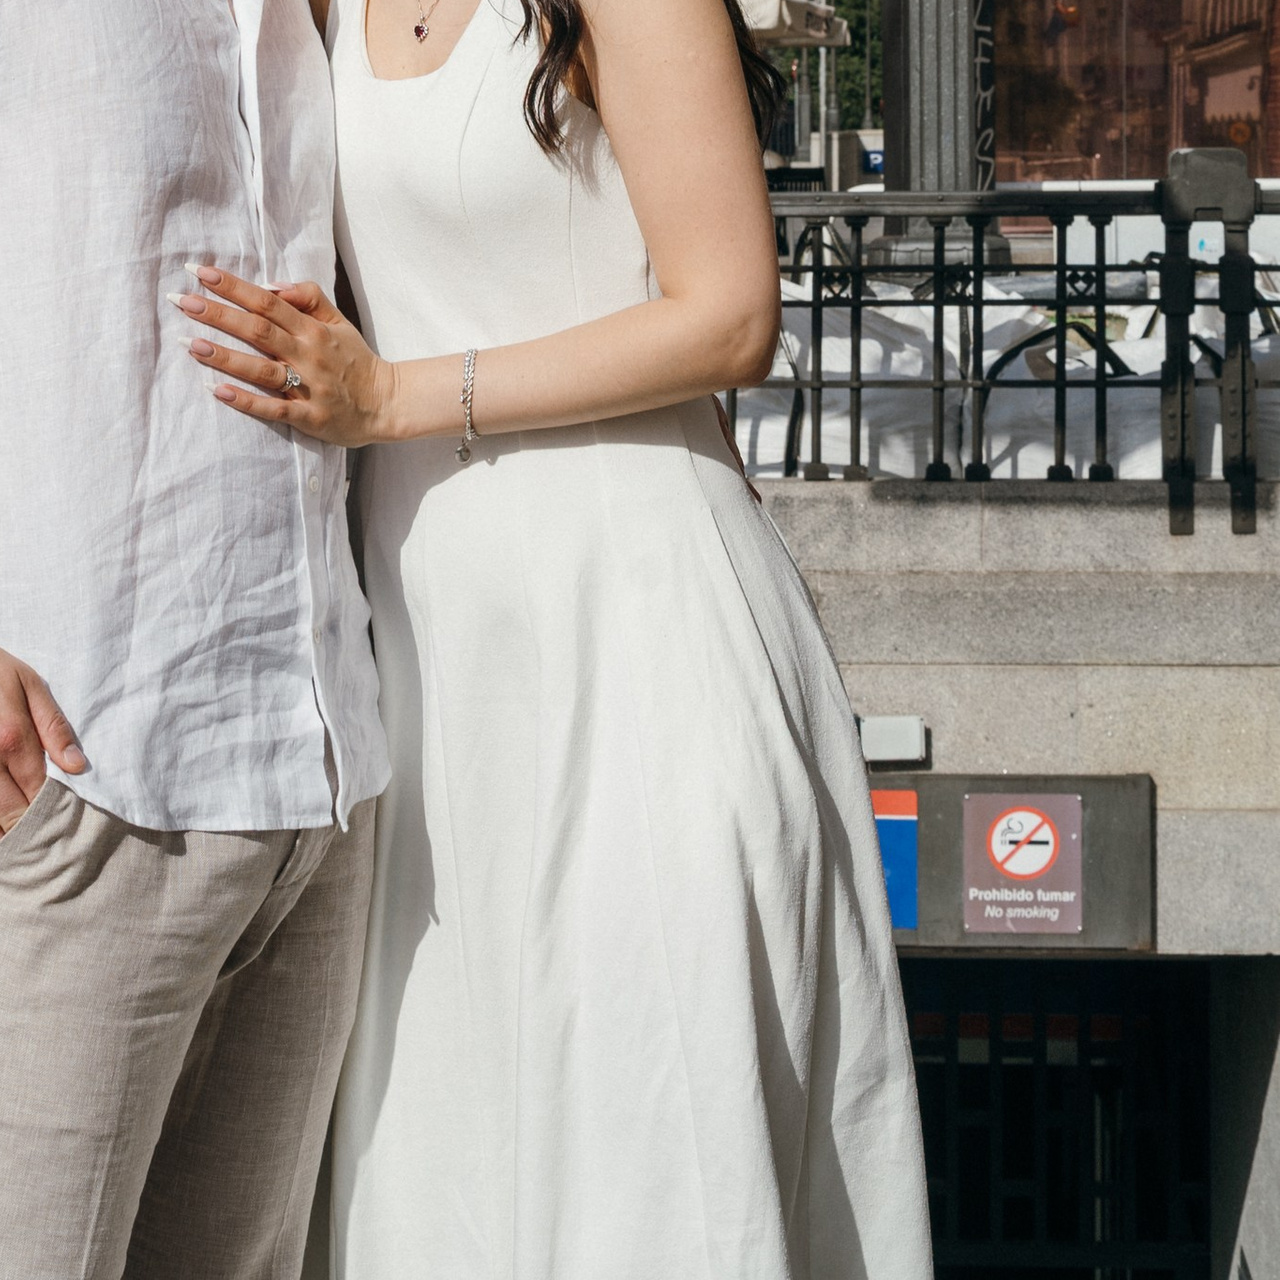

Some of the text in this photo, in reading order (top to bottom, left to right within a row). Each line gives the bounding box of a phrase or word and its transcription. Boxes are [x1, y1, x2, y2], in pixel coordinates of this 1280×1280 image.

[869, 153, 883, 168] P
[968, 887, 1077, 902] Prohibido fumar
[984, 904, 1060, 922] No smoking
